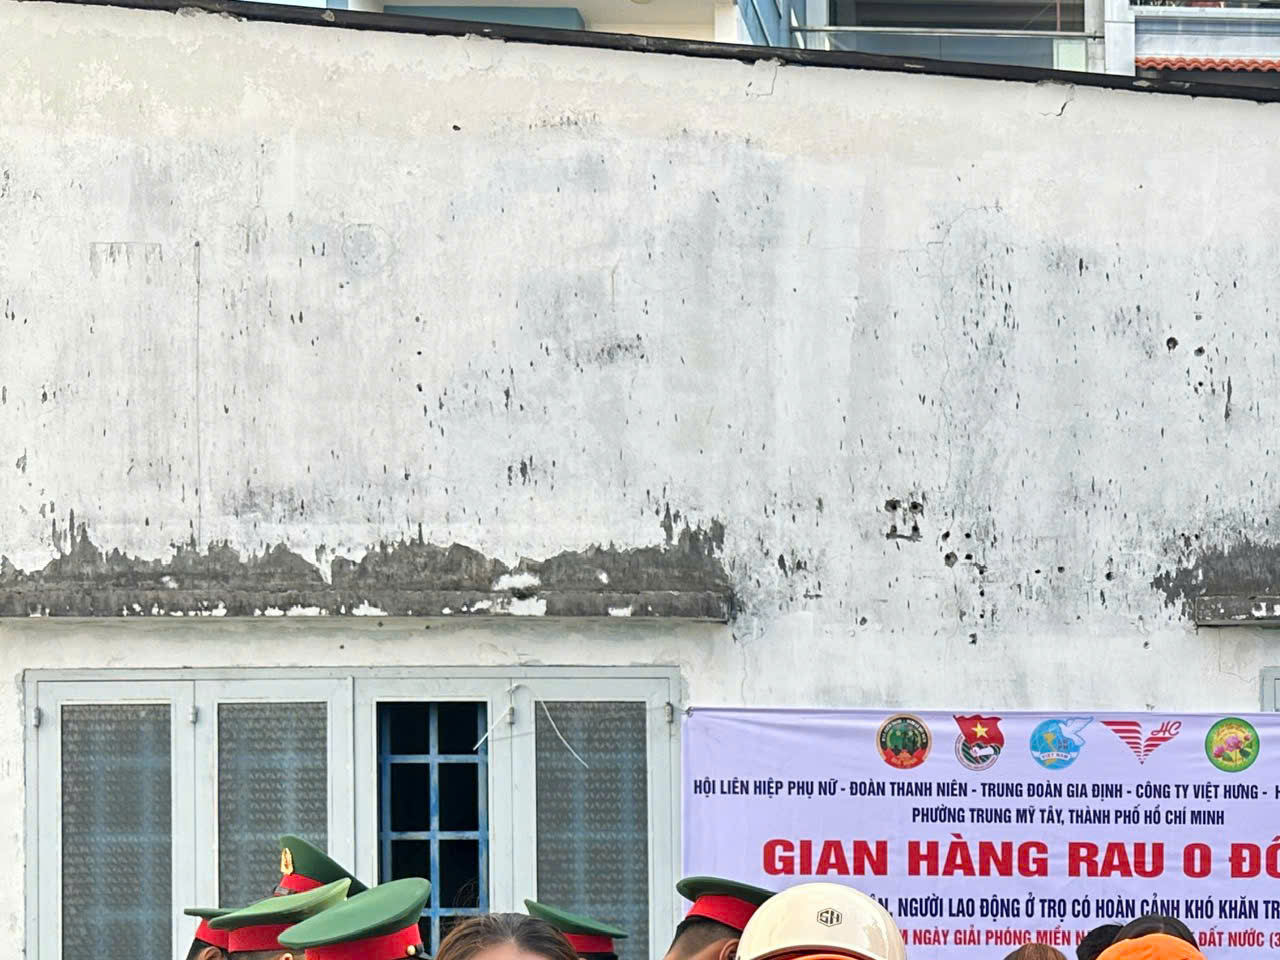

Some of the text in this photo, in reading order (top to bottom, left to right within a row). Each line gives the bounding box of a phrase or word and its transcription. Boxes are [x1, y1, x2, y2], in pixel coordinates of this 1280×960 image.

[693, 776, 716, 799] HỘI
[720, 777, 749, 795] LIÊN
[753, 777, 783, 799] HIỆP
[788, 780, 814, 799] PHỤ
[818, 778, 845, 796] NỮ
[850, 778, 886, 797] ĐOÀN
[890, 782, 932, 797] THANH
[937, 778, 967, 797] NIÊN
[981, 783, 1023, 798] TRUNG
[1027, 780, 1062, 798] ĐOÀN
[1067, 784, 1088, 799] GIA
[1092, 784, 1122, 802] ĐỊNH
[1136, 781, 1170, 799] CÔNG
[1174, 784, 1190, 799] TY
[1193, 781, 1220, 803] VIỆT
[1224, 783, 1258, 799] HƯNG
[912, 804, 965, 824] PHƯỜNG
[969, 808, 1012, 824] TRUNG
[1016, 805, 1036, 824] MỸ
[1039, 805, 1064, 826] TÂY,
[1068, 806, 1111, 825] THÀNH
[1114, 803, 1141, 825] PHỐ
[1165, 805, 1187, 825] CHÍ
[1190, 809, 1225, 825] MINH
[763, 838, 888, 876] GIAN
[908, 832, 1049, 877] HÀNG
[1068, 841, 1165, 878] RAU
[898, 893, 943, 918] NGƯỜI
[949, 898, 975, 918] LAO
[980, 894, 1020, 922] ĐỘNG
[1025, 892, 1035, 918] Ở
[1039, 899, 1067, 922] TRỌ
[1071, 894, 1091, 919] CÓ
[1095, 895, 1136, 919] HOÀN
[1140, 892, 1181, 919] CẢNH
[1185, 896, 1214, 919] KHÓ
[1218, 896, 1259, 920] KHĂN
[913, 926, 949, 945] NGÀY
[954, 924, 981, 946] GIẢI
[985, 926, 1031, 946] PHÓNG
[1036, 925, 1071, 946] MIỀN
[1199, 925, 1224, 948] ĐẤT
[1228, 926, 1264, 948] NƯỚC
